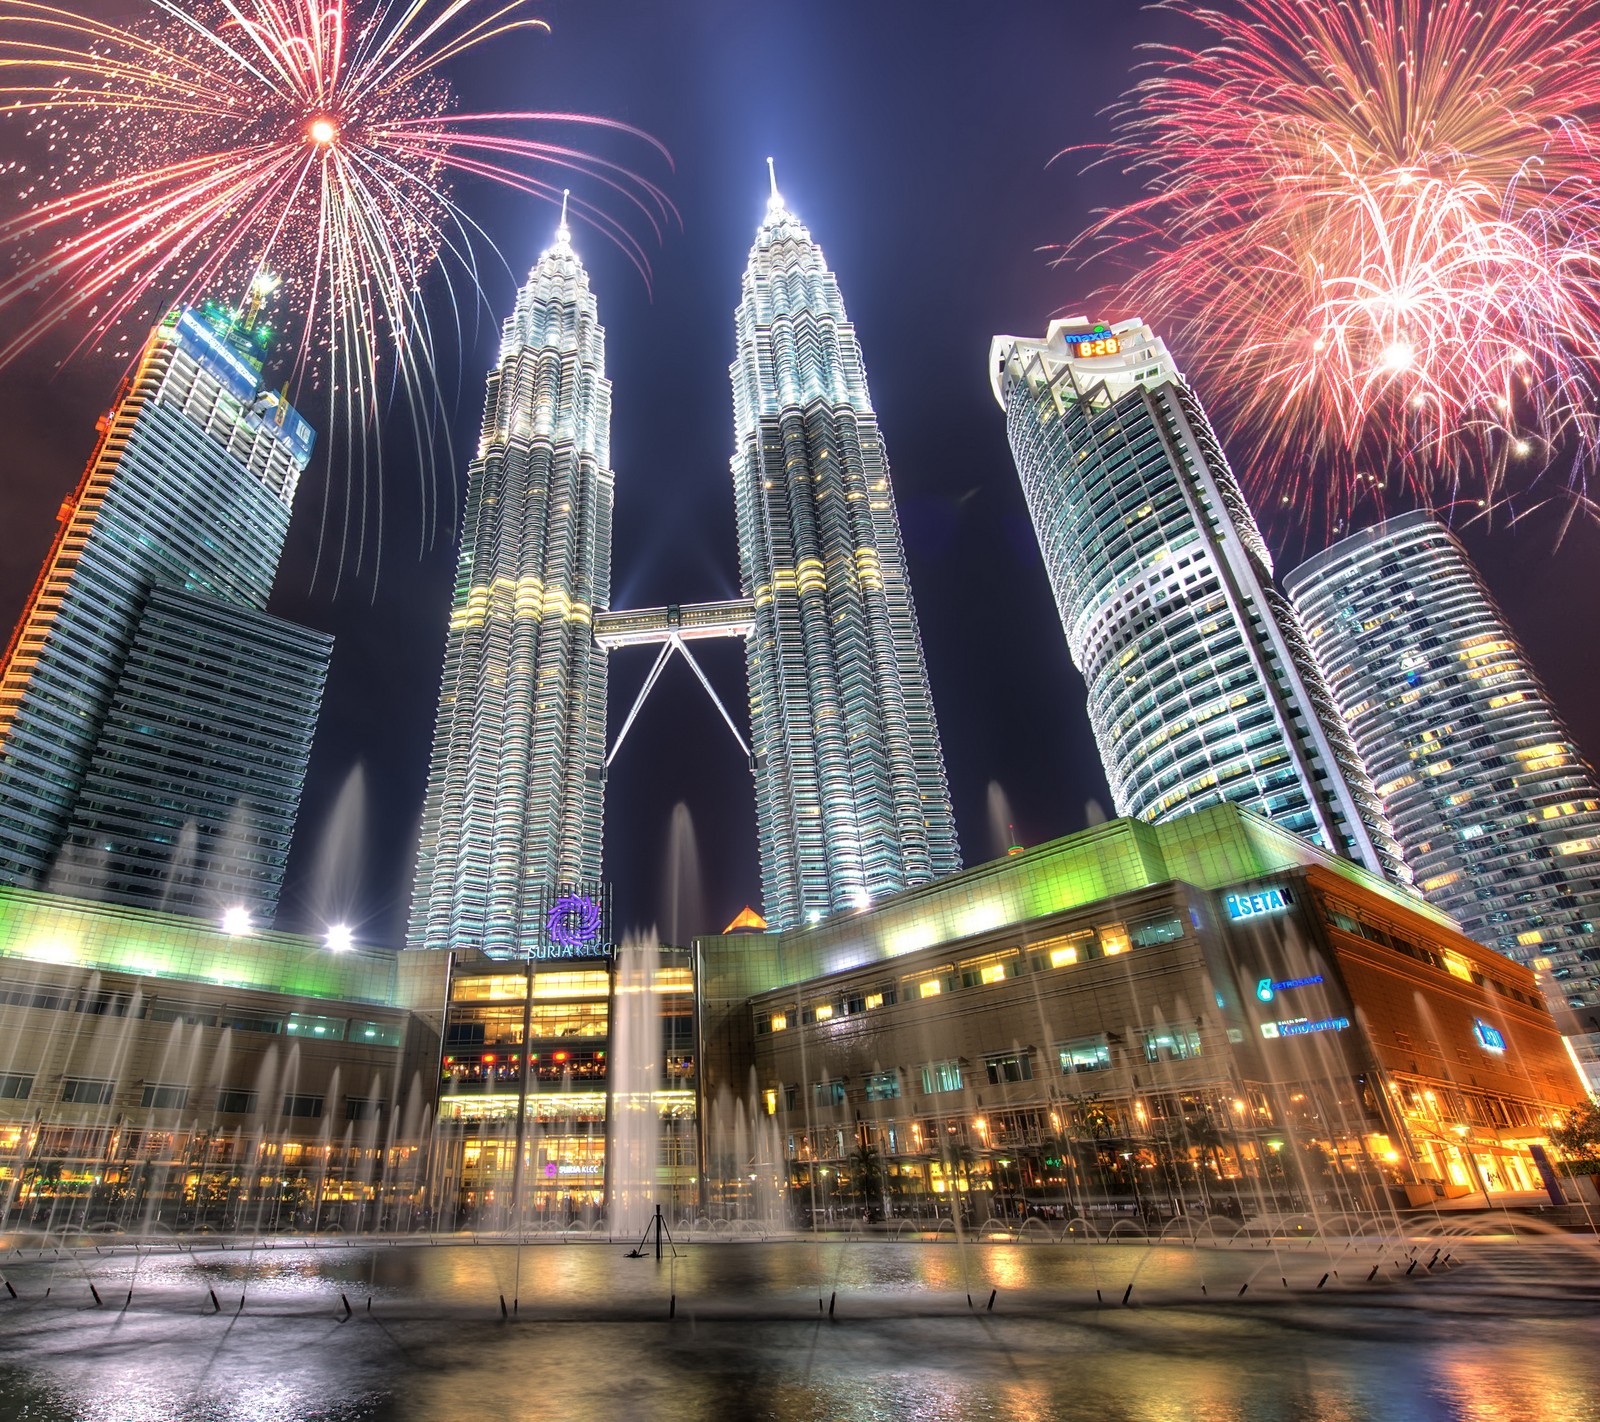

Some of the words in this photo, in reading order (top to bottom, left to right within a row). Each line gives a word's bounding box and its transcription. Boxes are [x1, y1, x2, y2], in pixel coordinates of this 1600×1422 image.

[1065, 327, 1112, 344] maxis
[1080, 338, 1118, 357] 8:28
[528, 945, 573, 959] SURIA
[576, 943, 613, 956] KLCC
[558, 1165, 581, 1174] SURIA
[582, 1165, 599, 1174] KLCC
